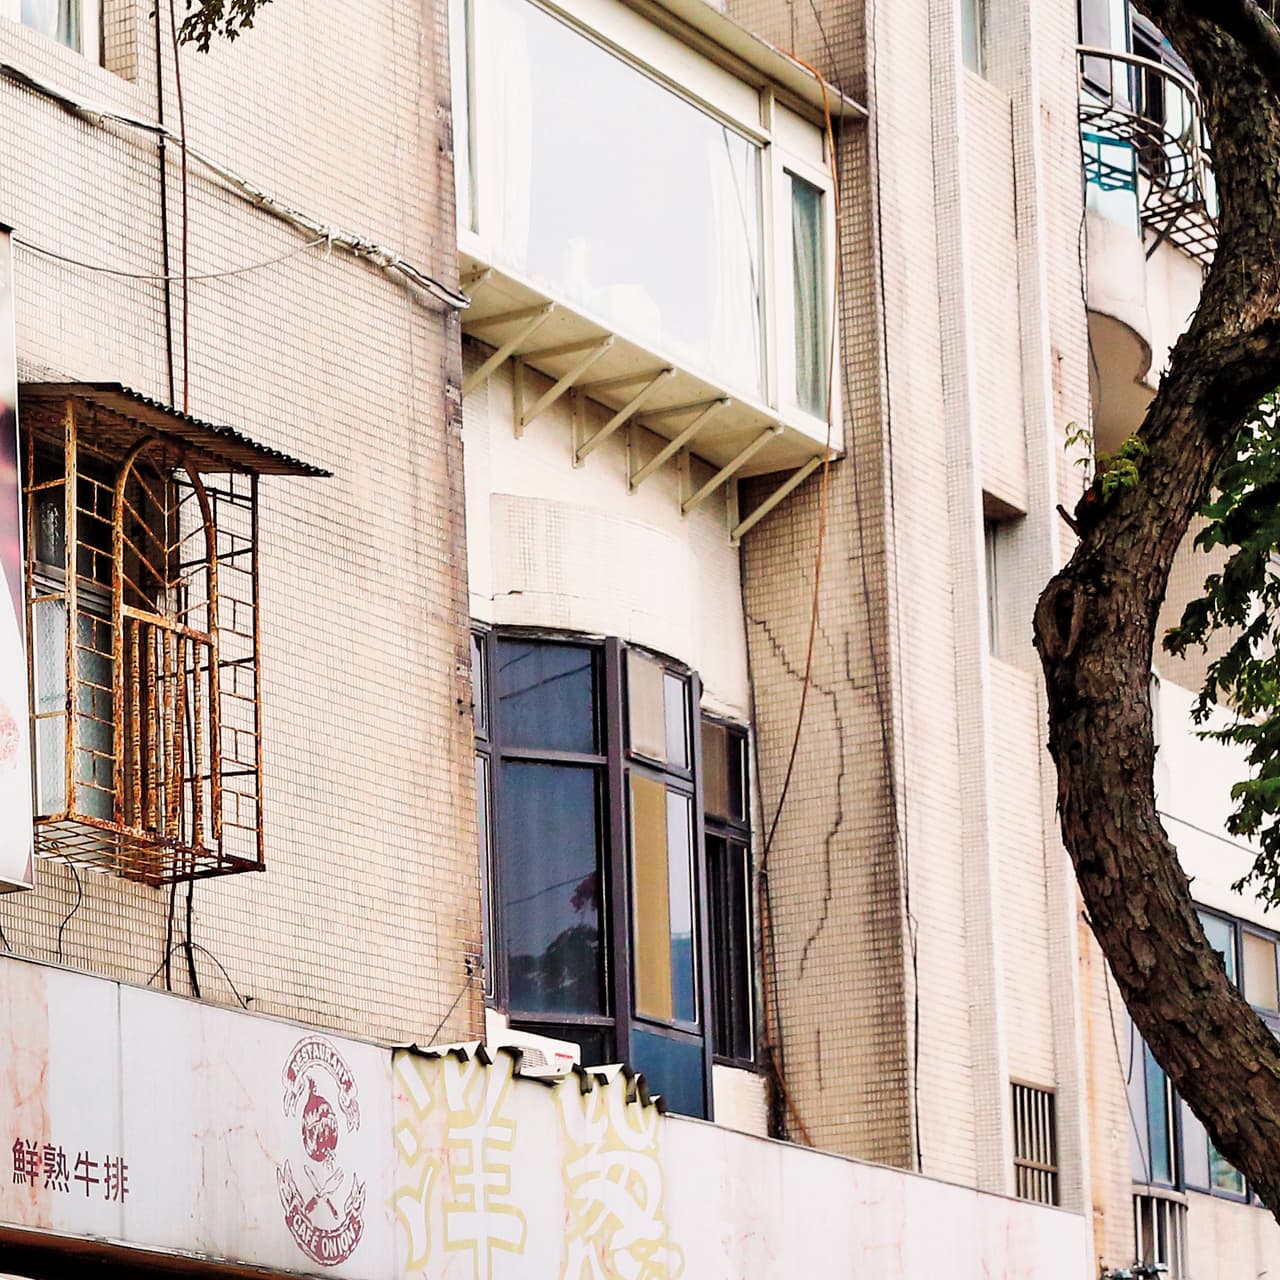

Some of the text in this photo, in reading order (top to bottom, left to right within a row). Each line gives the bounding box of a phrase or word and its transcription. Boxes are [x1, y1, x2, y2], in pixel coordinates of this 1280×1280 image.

[290, 1042, 348, 1083] RESTAURANT
[12, 1137, 129, 1203] 鮮熟牛排
[321, 1223, 356, 1258] ONION
